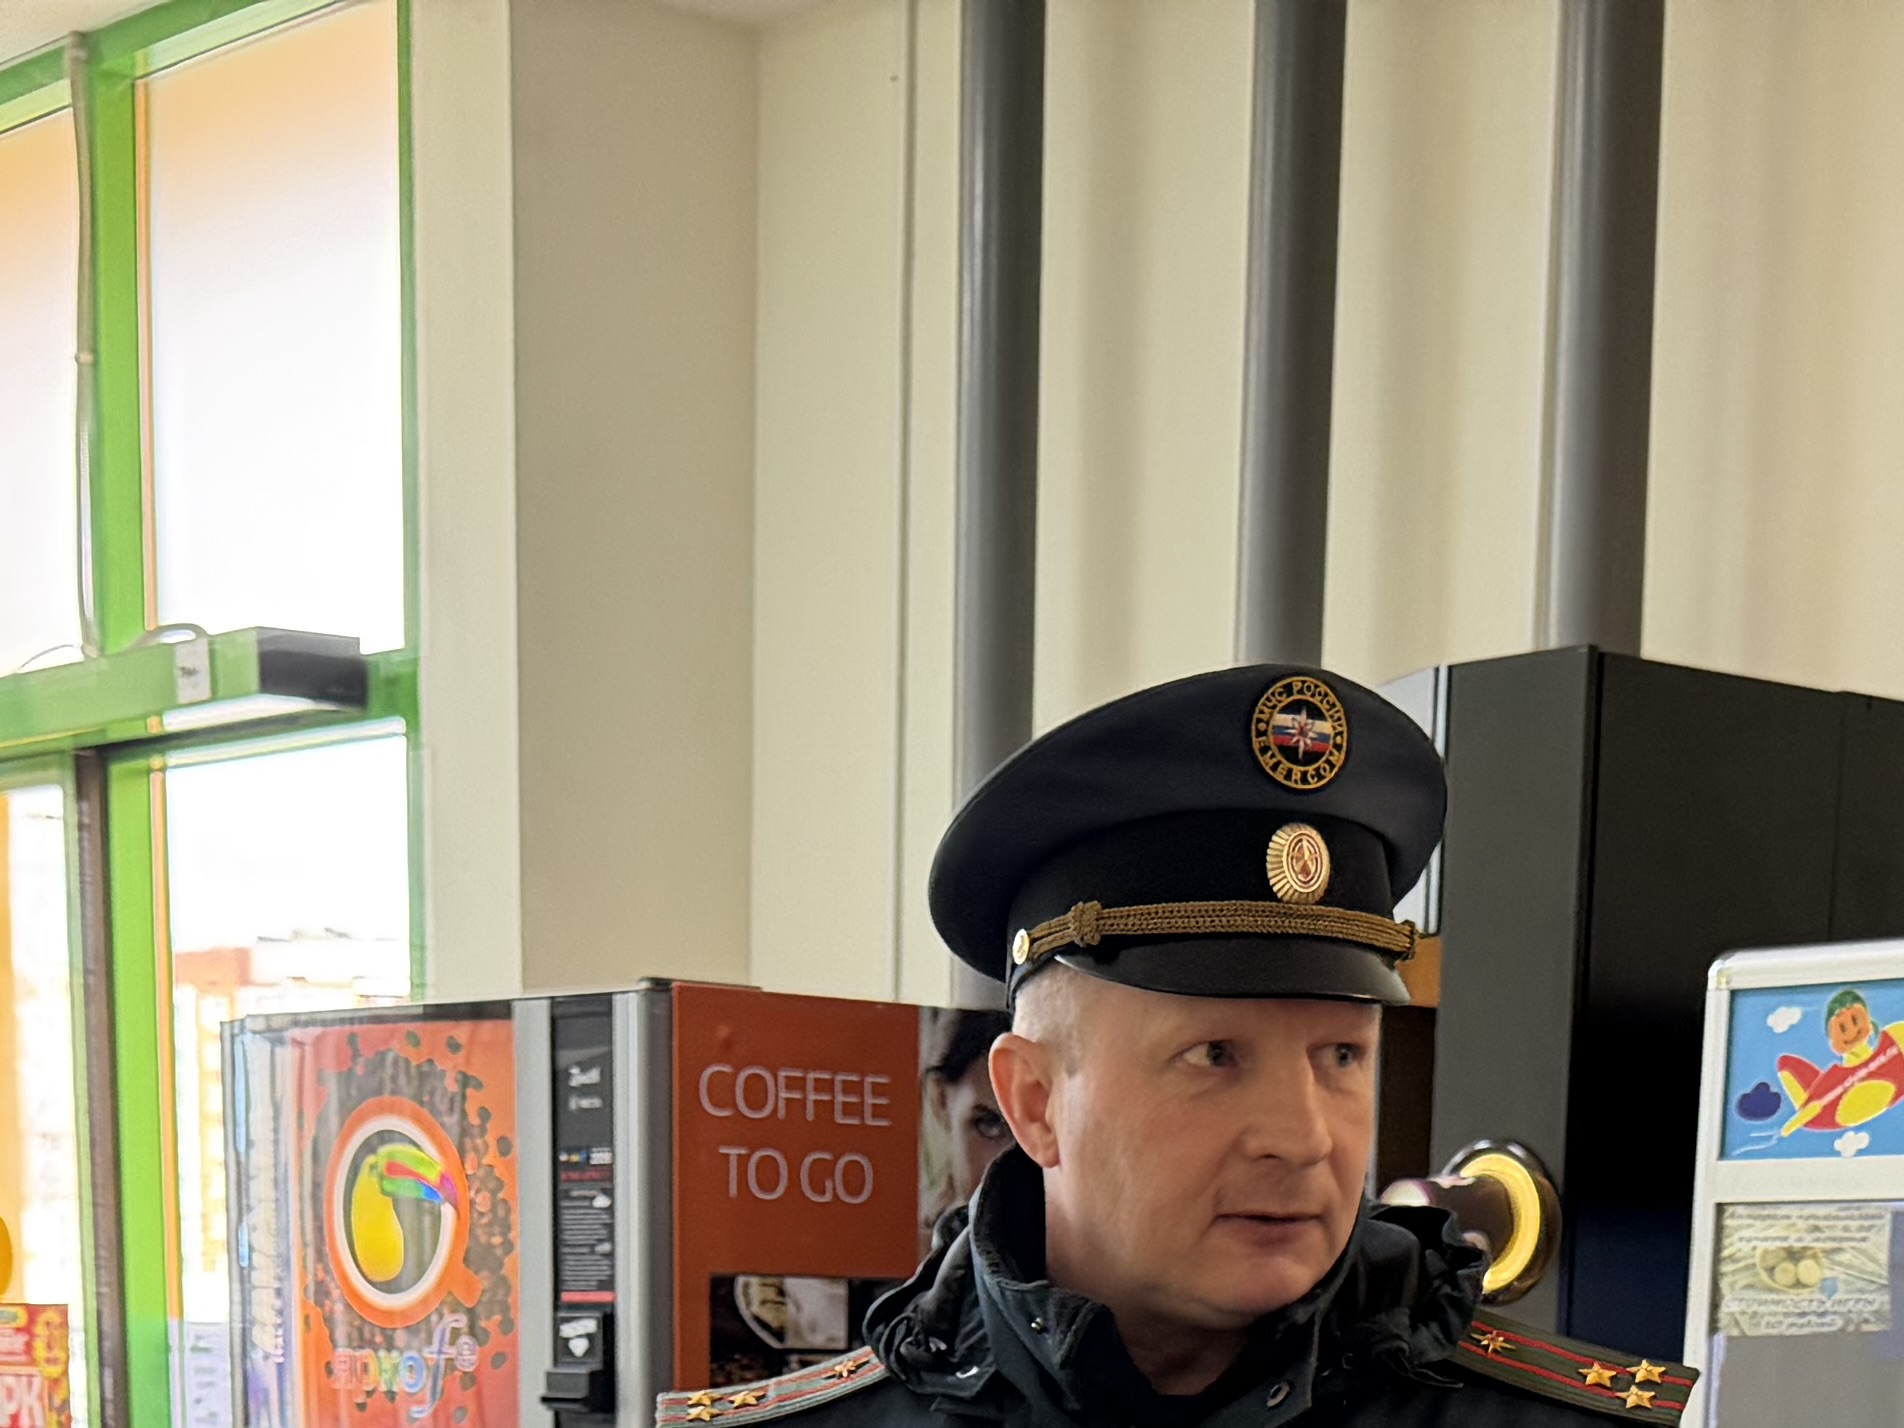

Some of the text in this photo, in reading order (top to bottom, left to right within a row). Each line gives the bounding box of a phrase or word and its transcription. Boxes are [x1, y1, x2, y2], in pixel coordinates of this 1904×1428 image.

[1293, 681, 1344, 731] РОССИИ
[699, 1063, 892, 1127] COFFEE
[719, 1145, 874, 1204] TO GO
